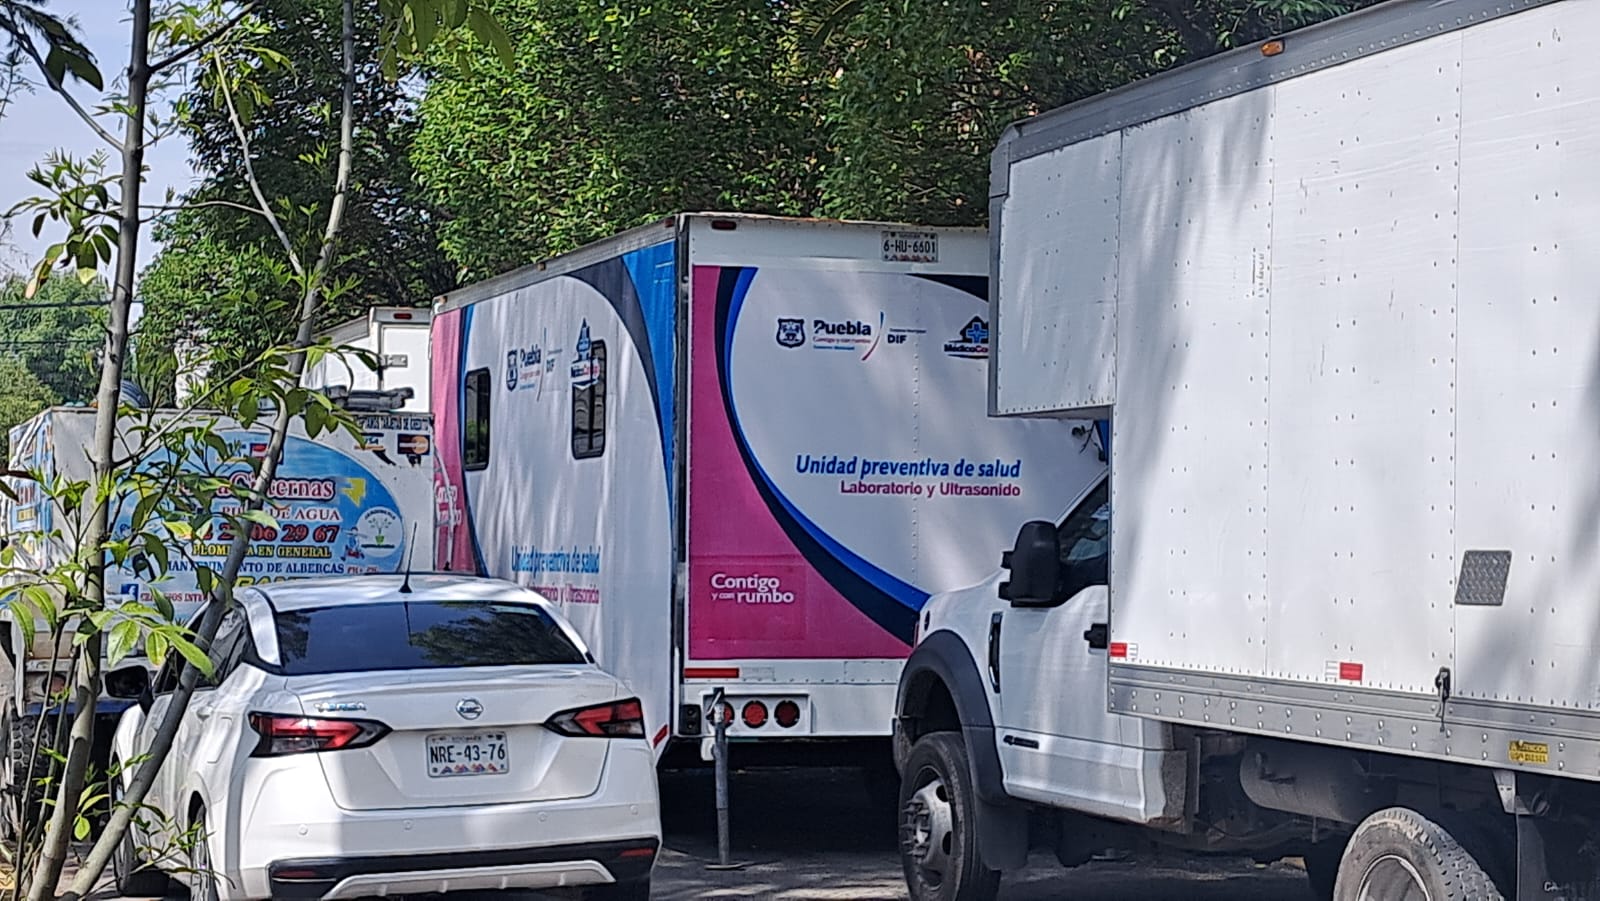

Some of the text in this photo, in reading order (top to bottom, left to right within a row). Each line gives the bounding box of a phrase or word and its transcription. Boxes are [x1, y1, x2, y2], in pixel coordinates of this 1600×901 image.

[883, 239, 936, 253] 6-HU-6601
[813, 319, 871, 336] Puebla
[887, 334, 907, 344] DIF
[796, 454, 1021, 480] Unidad preventiva de salud
[840, 479, 1021, 498] Laboratorio y Ultrasonido
[294, 507, 341, 521] AGUA
[281, 523, 309, 543] 29
[313, 525, 340, 544] 67
[257, 544, 275, 557] EN
[276, 544, 332, 559] GENERAL
[266, 562, 283, 573] DE
[285, 562, 345, 574] ALBERCAS
[711, 573, 780, 592] Contigo
[711, 592, 718, 600] y
[737, 588, 795, 603] rumbo
[430, 743, 506, 763] NRE-43-76
